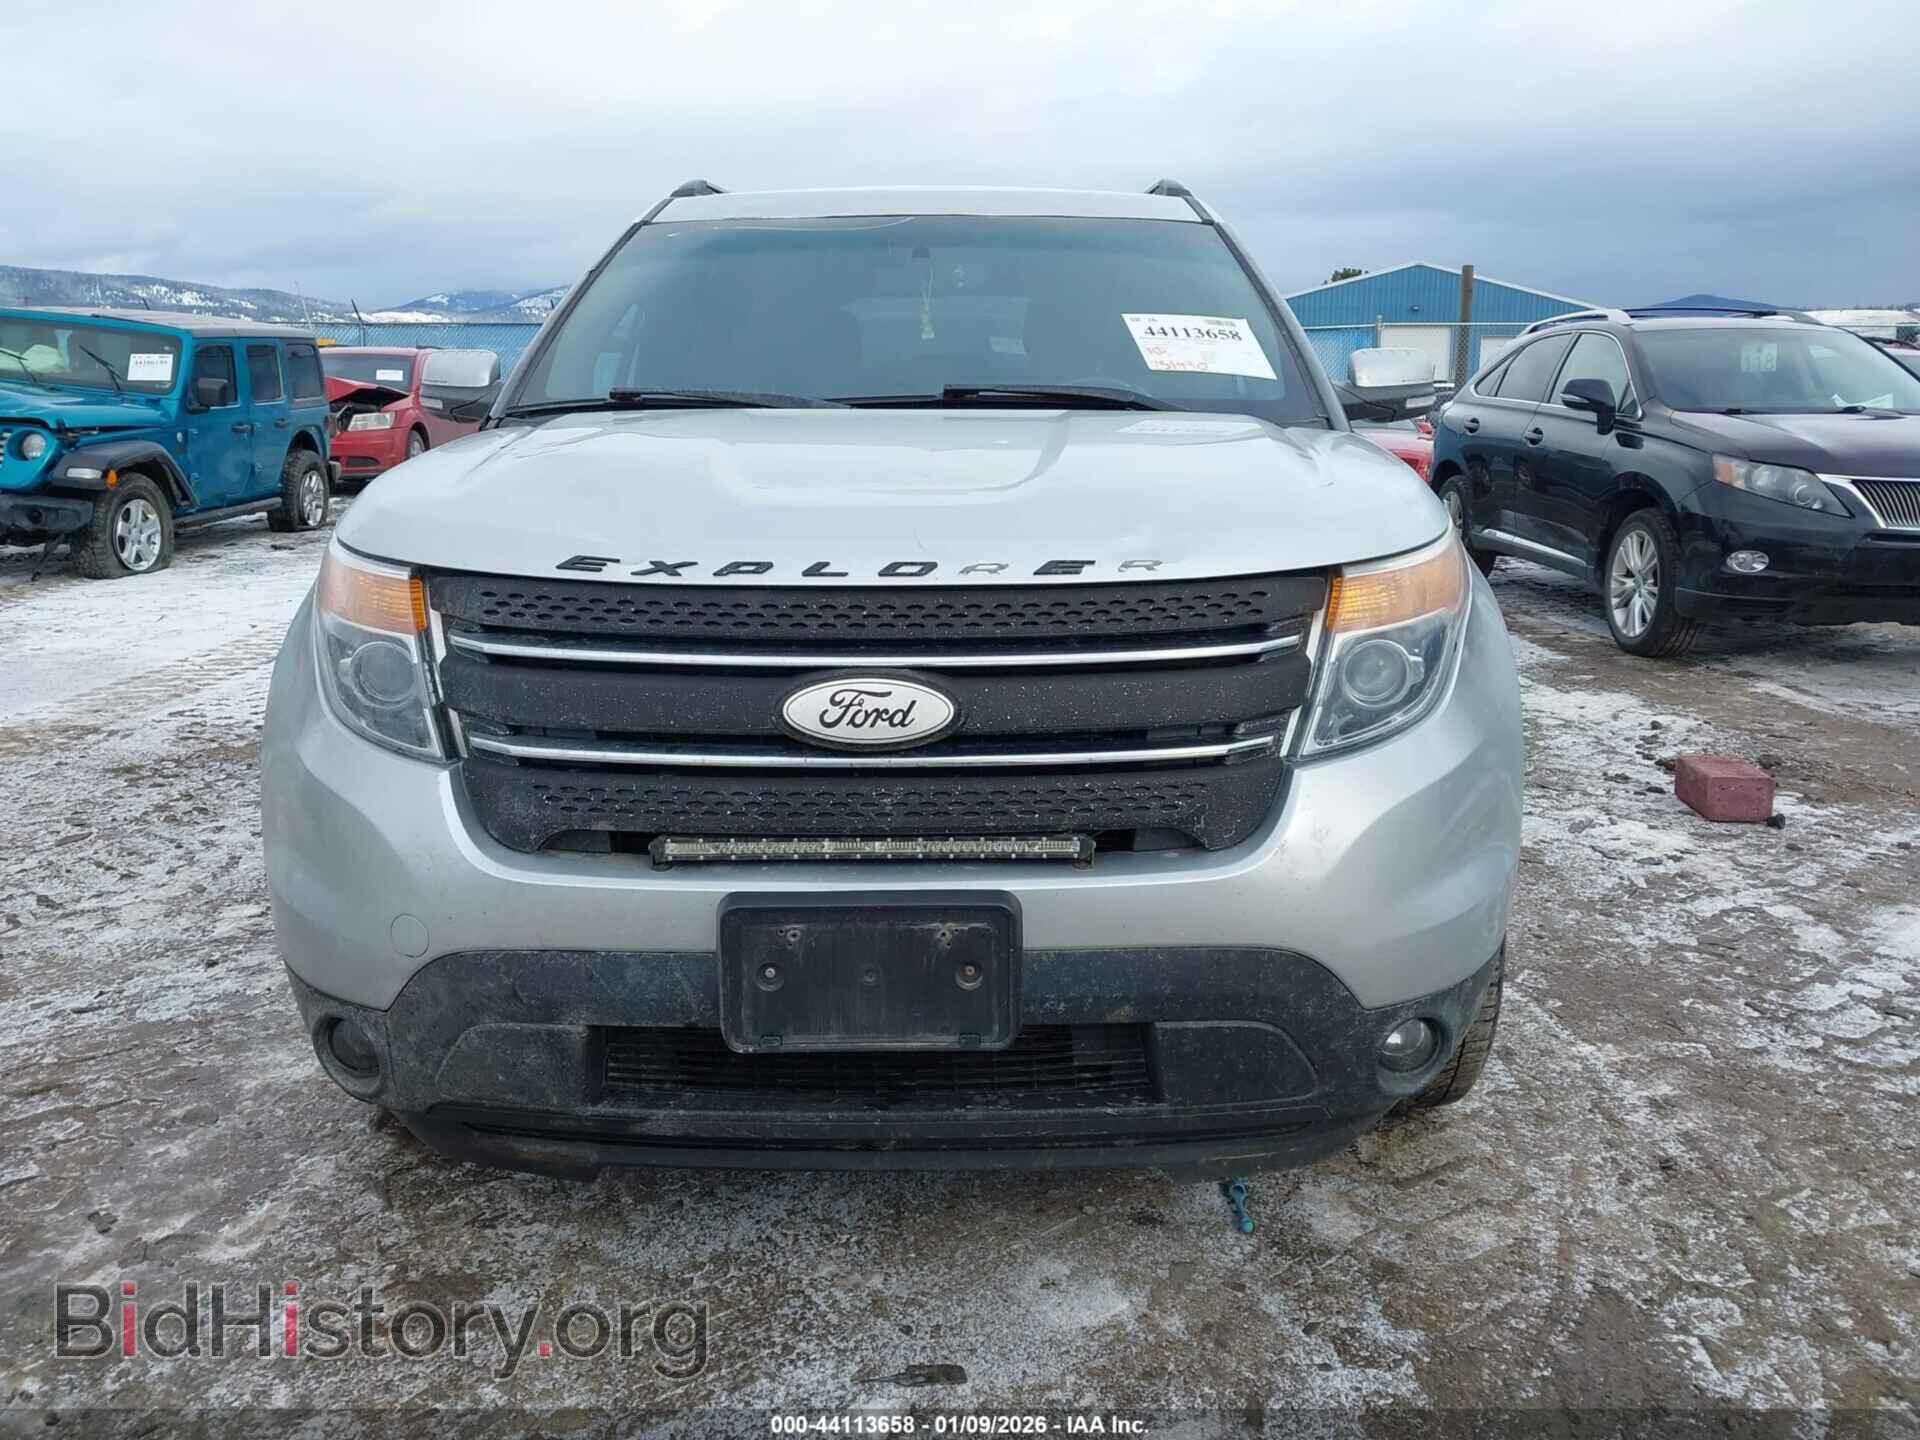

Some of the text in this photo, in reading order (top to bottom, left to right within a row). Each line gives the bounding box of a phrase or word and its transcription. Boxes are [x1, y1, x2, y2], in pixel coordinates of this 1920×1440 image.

[1144, 326, 1242, 341] 44113658
[556, 554, 1162, 577] EXPLORER
[819, 688, 917, 729] Ford
